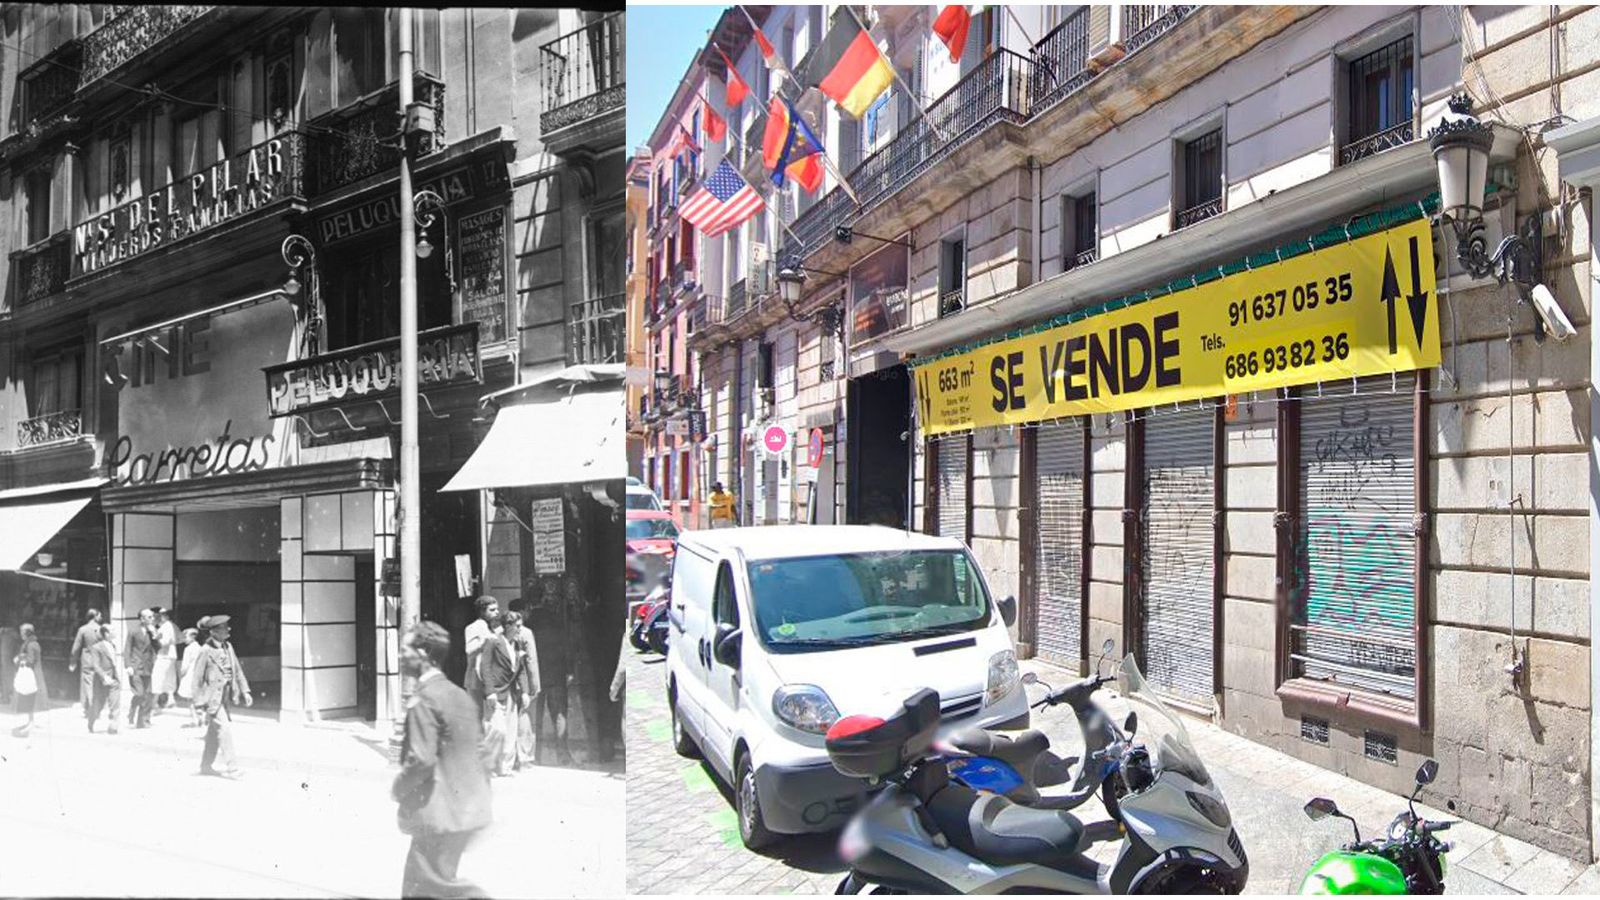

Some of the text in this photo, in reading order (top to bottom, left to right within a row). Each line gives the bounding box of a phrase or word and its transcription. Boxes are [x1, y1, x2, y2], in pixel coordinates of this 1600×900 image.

[130, 186, 179, 231] DEL
[191, 139, 282, 207] PILAR
[322, 174, 466, 243] PELUQURIA
[82, 183, 272, 273] VIAJEROS FAMILIAS
[1228, 272, 1353, 327] 91 637 05 35
[101, 312, 212, 393] CINE
[990, 311, 1182, 413] SE VENDE
[1200, 333, 1226, 352] Tels.
[1225, 351, 1258, 379] 686
[1321, 332, 1349, 362] 36
[938, 366, 959, 393] 663
[108, 418, 276, 485] Carretas
